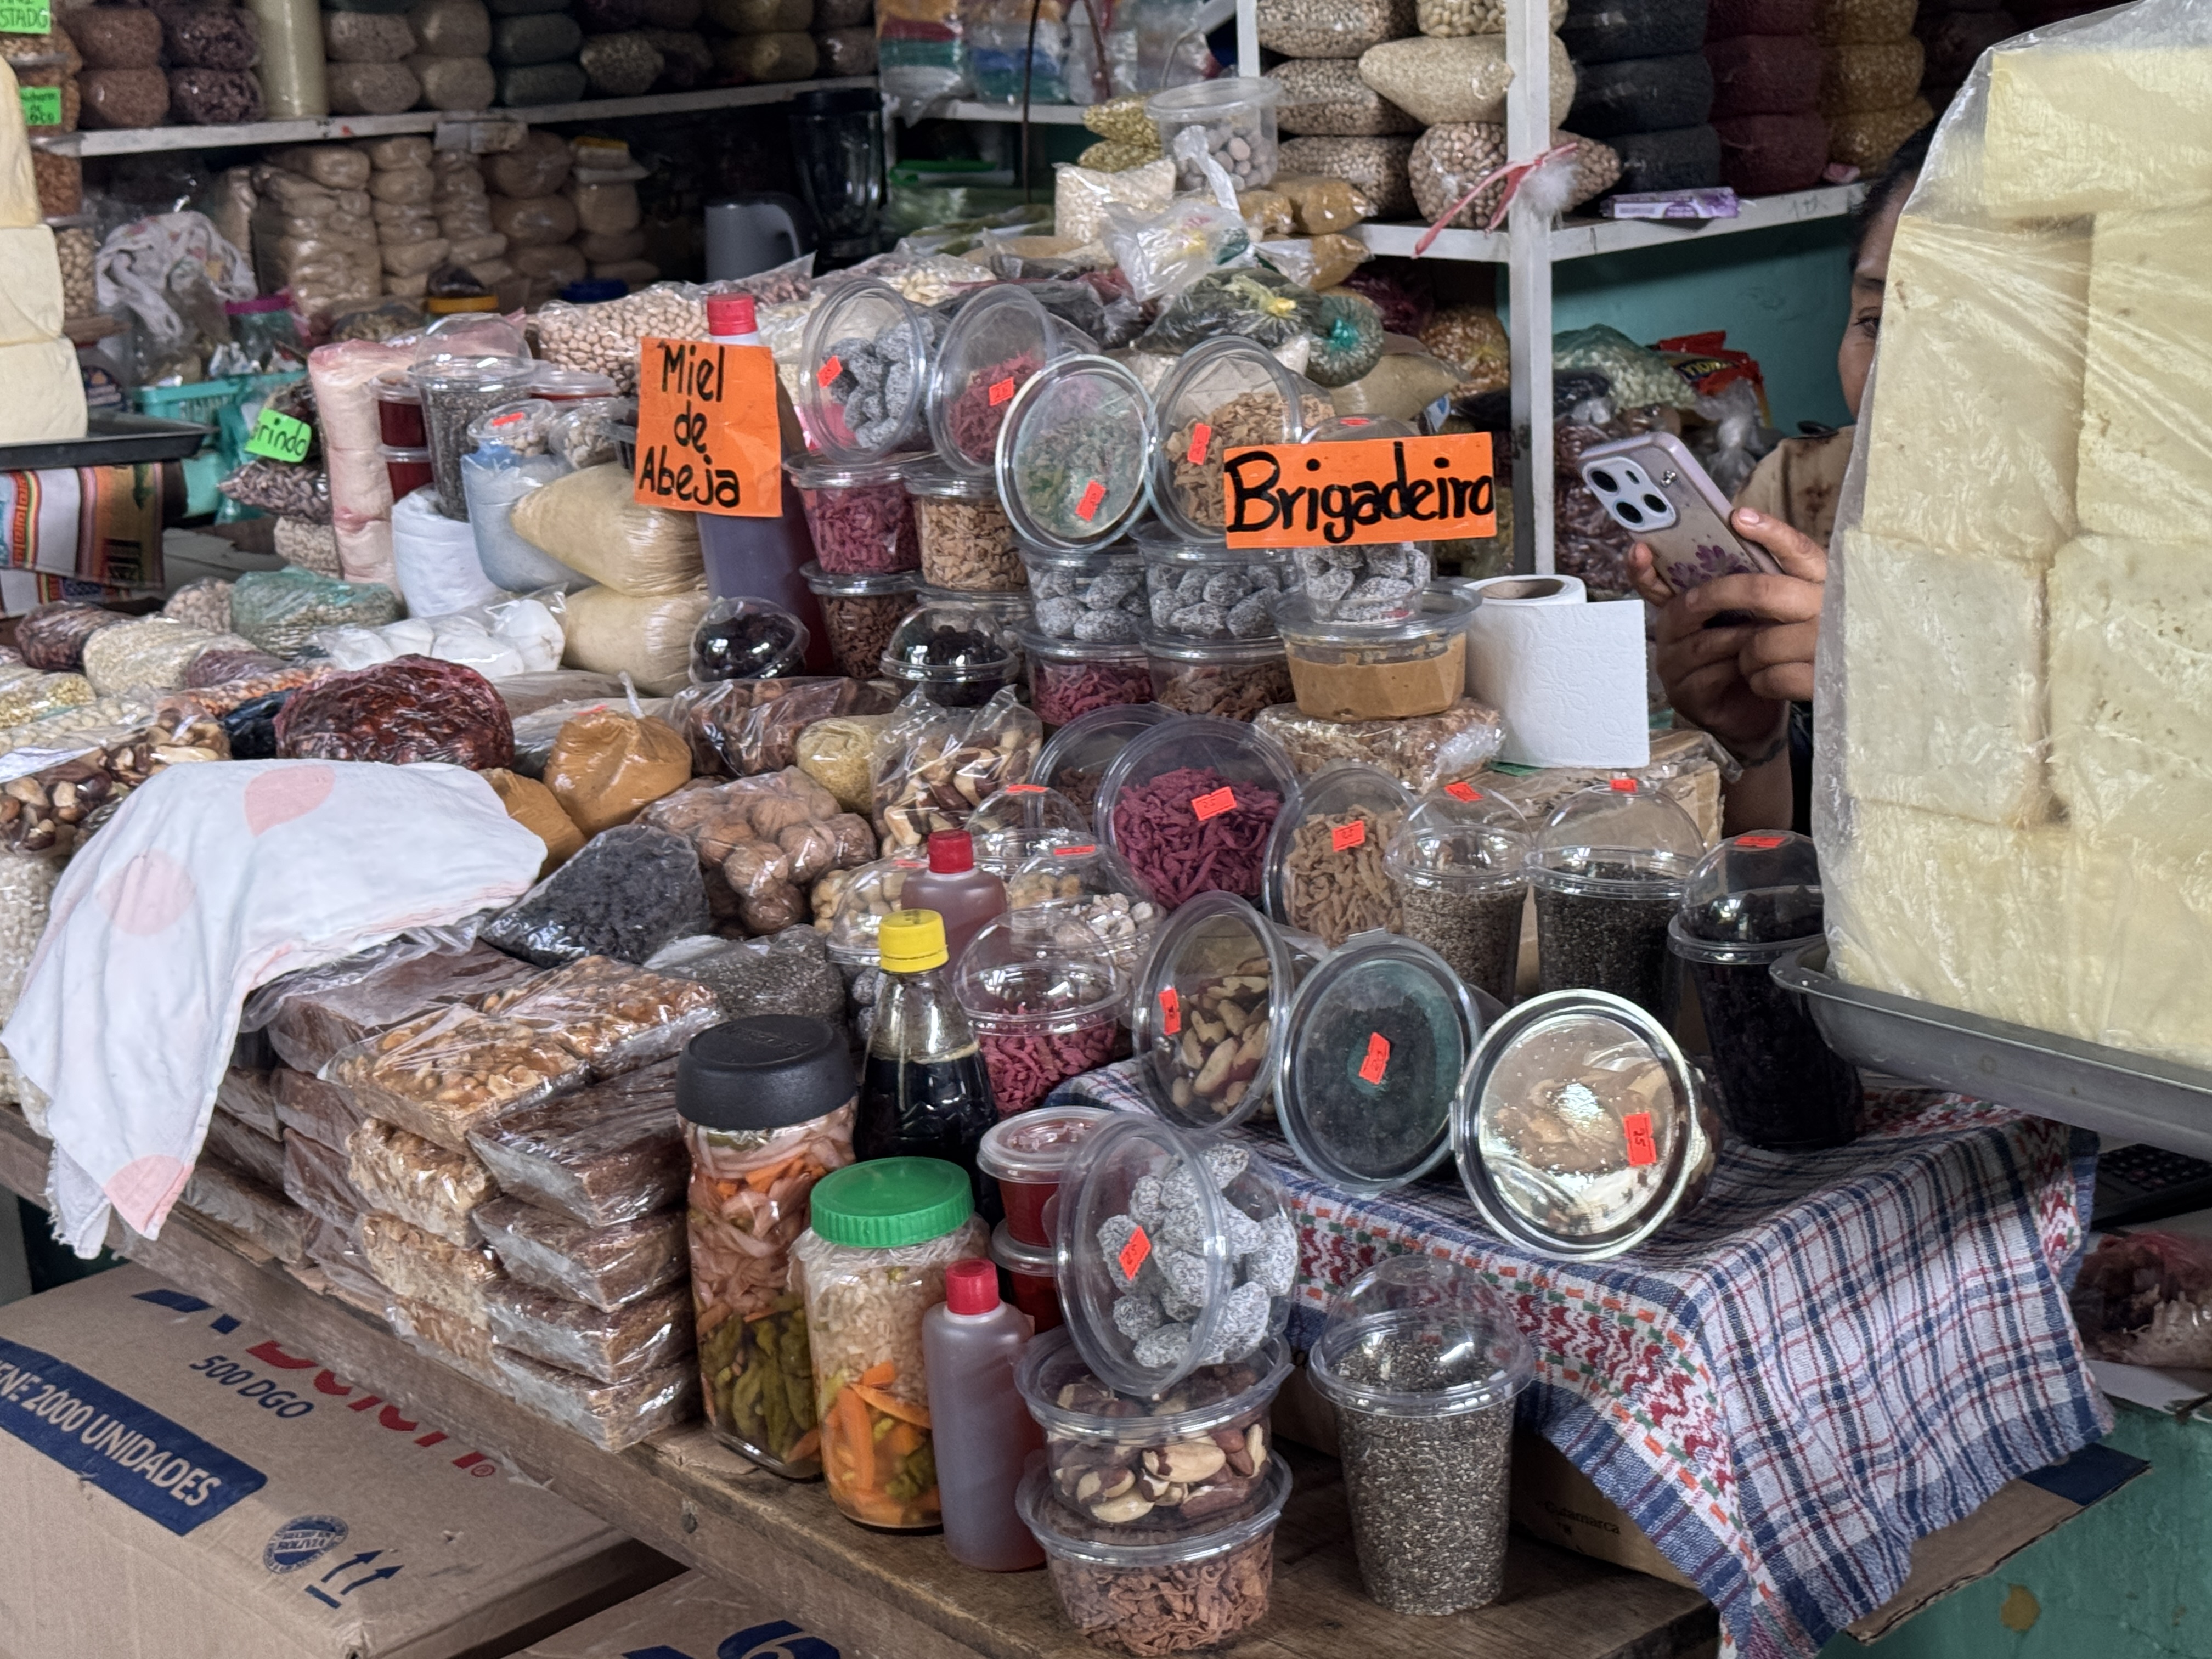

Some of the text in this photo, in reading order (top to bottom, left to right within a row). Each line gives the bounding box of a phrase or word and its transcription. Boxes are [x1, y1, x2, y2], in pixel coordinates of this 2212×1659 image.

[660, 344, 725, 402] Miel
[674, 399, 707, 454] de
[638, 445, 740, 508] Abeja
[1223, 441, 1495, 544] Brigadeiro
[189, 1355, 314, 1418] 500 DGO
[21, 1384, 94, 1432] 2000
[80, 1413, 222, 1506] UNIDADES
